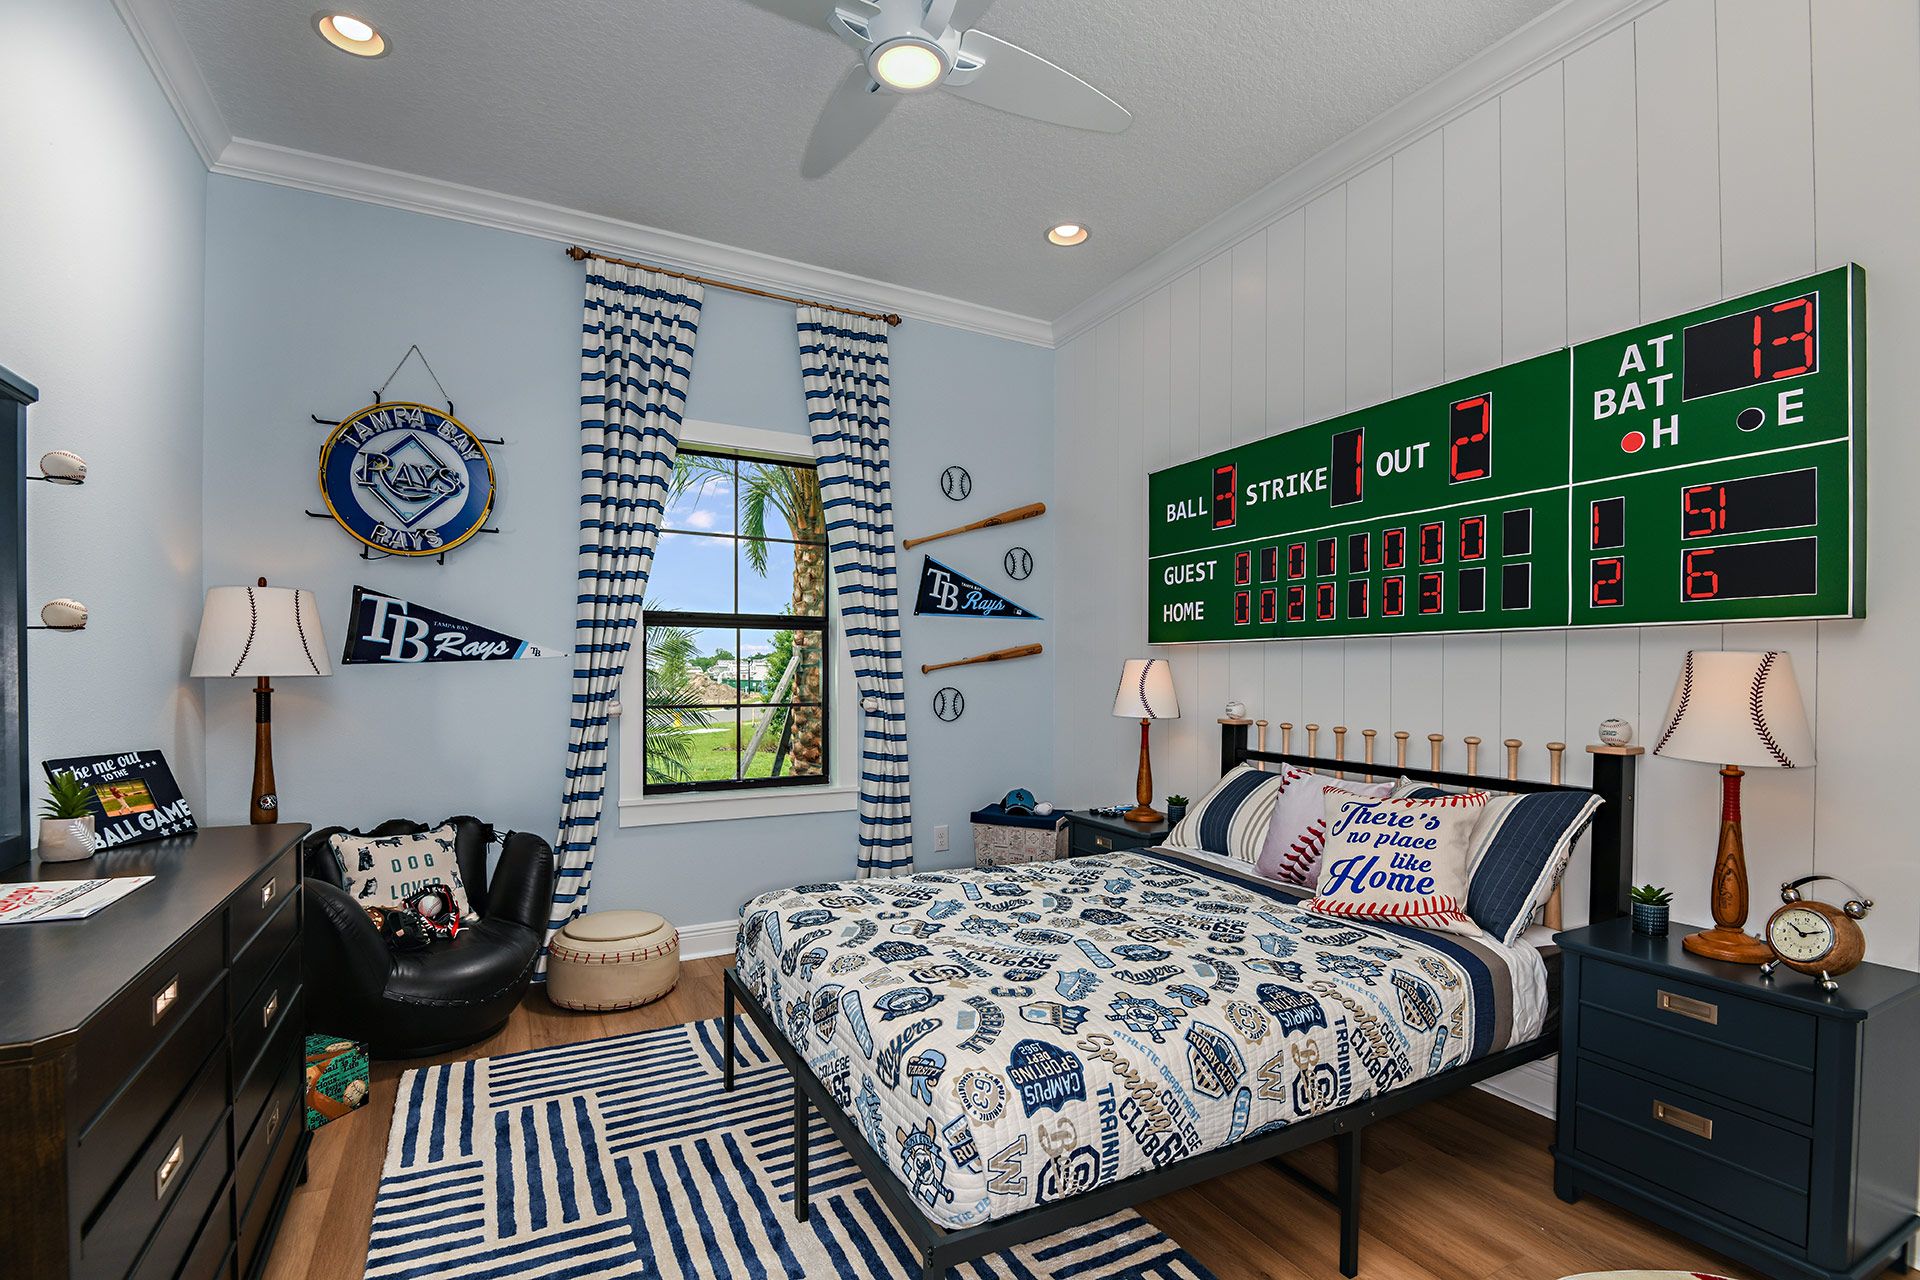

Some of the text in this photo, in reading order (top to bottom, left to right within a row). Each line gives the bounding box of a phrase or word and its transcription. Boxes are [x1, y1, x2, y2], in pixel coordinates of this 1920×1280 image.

[1618, 333, 1673, 378] AT
[1753, 298, 1813, 380] 13
[1594, 372, 1673, 421] BAT
[1778, 388, 1804, 426] E
[338, 406, 484, 461] TAMPA BAY
[1652, 414, 1679, 450] H
[1166, 496, 1208, 523] BALL
[1216, 463, 1236, 528] 3
[1246, 466, 1328, 506] STRIKE
[1376, 442, 1430, 477] OUT
[1450, 397, 1489, 481] 2
[1684, 486, 1726, 536] 51
[370, 523, 444, 550] RAYS
[927, 568, 960, 612] TB
[1164, 560, 1218, 585] GUEST
[1594, 549, 1718, 605] 2 6
[961, 590, 1006, 616] Rays
[1163, 601, 1205, 623] HOME
[361, 594, 430, 664] TB
[434, 620, 456, 630] TAMPA
[434, 632, 510, 661] Rays
[51, 752, 142, 782] Tke me out
[101, 768, 129, 782] TO THE
[94, 798, 192, 850] BALL GAME
[1332, 800, 1440, 836] There's
[1346, 830, 1437, 850] no place
[391, 854, 434, 873] DOG
[1322, 855, 1435, 896] Home
[1390, 852, 1432, 872] like
[1017, 956, 1058, 970] 65
[1278, 1005, 1322, 1028] CAMPUS
[1011, 1054, 1078, 1084] SPORTING
[1026, 1050, 1052, 1064] DEPT
[1188, 1032, 1236, 1092] RUGBY CLUB
[1350, 1028, 1382, 1079] CLUB
[1380, 1022, 1413, 1079] COLLEGE
[972, 1078, 992, 1109] 63
[1024, 1072, 1080, 1105] CAMPUS
[1076, 1033, 1173, 1136] Sporting
[1112, 1030, 1161, 1068] ATHLETIC
[1159, 1064, 1201, 1124] DEPARTMENT
[1096, 1082, 1120, 1182] TRAININ
[1118, 1096, 1160, 1158] CLUB
[1160, 1090, 1203, 1152] COLLEGE
